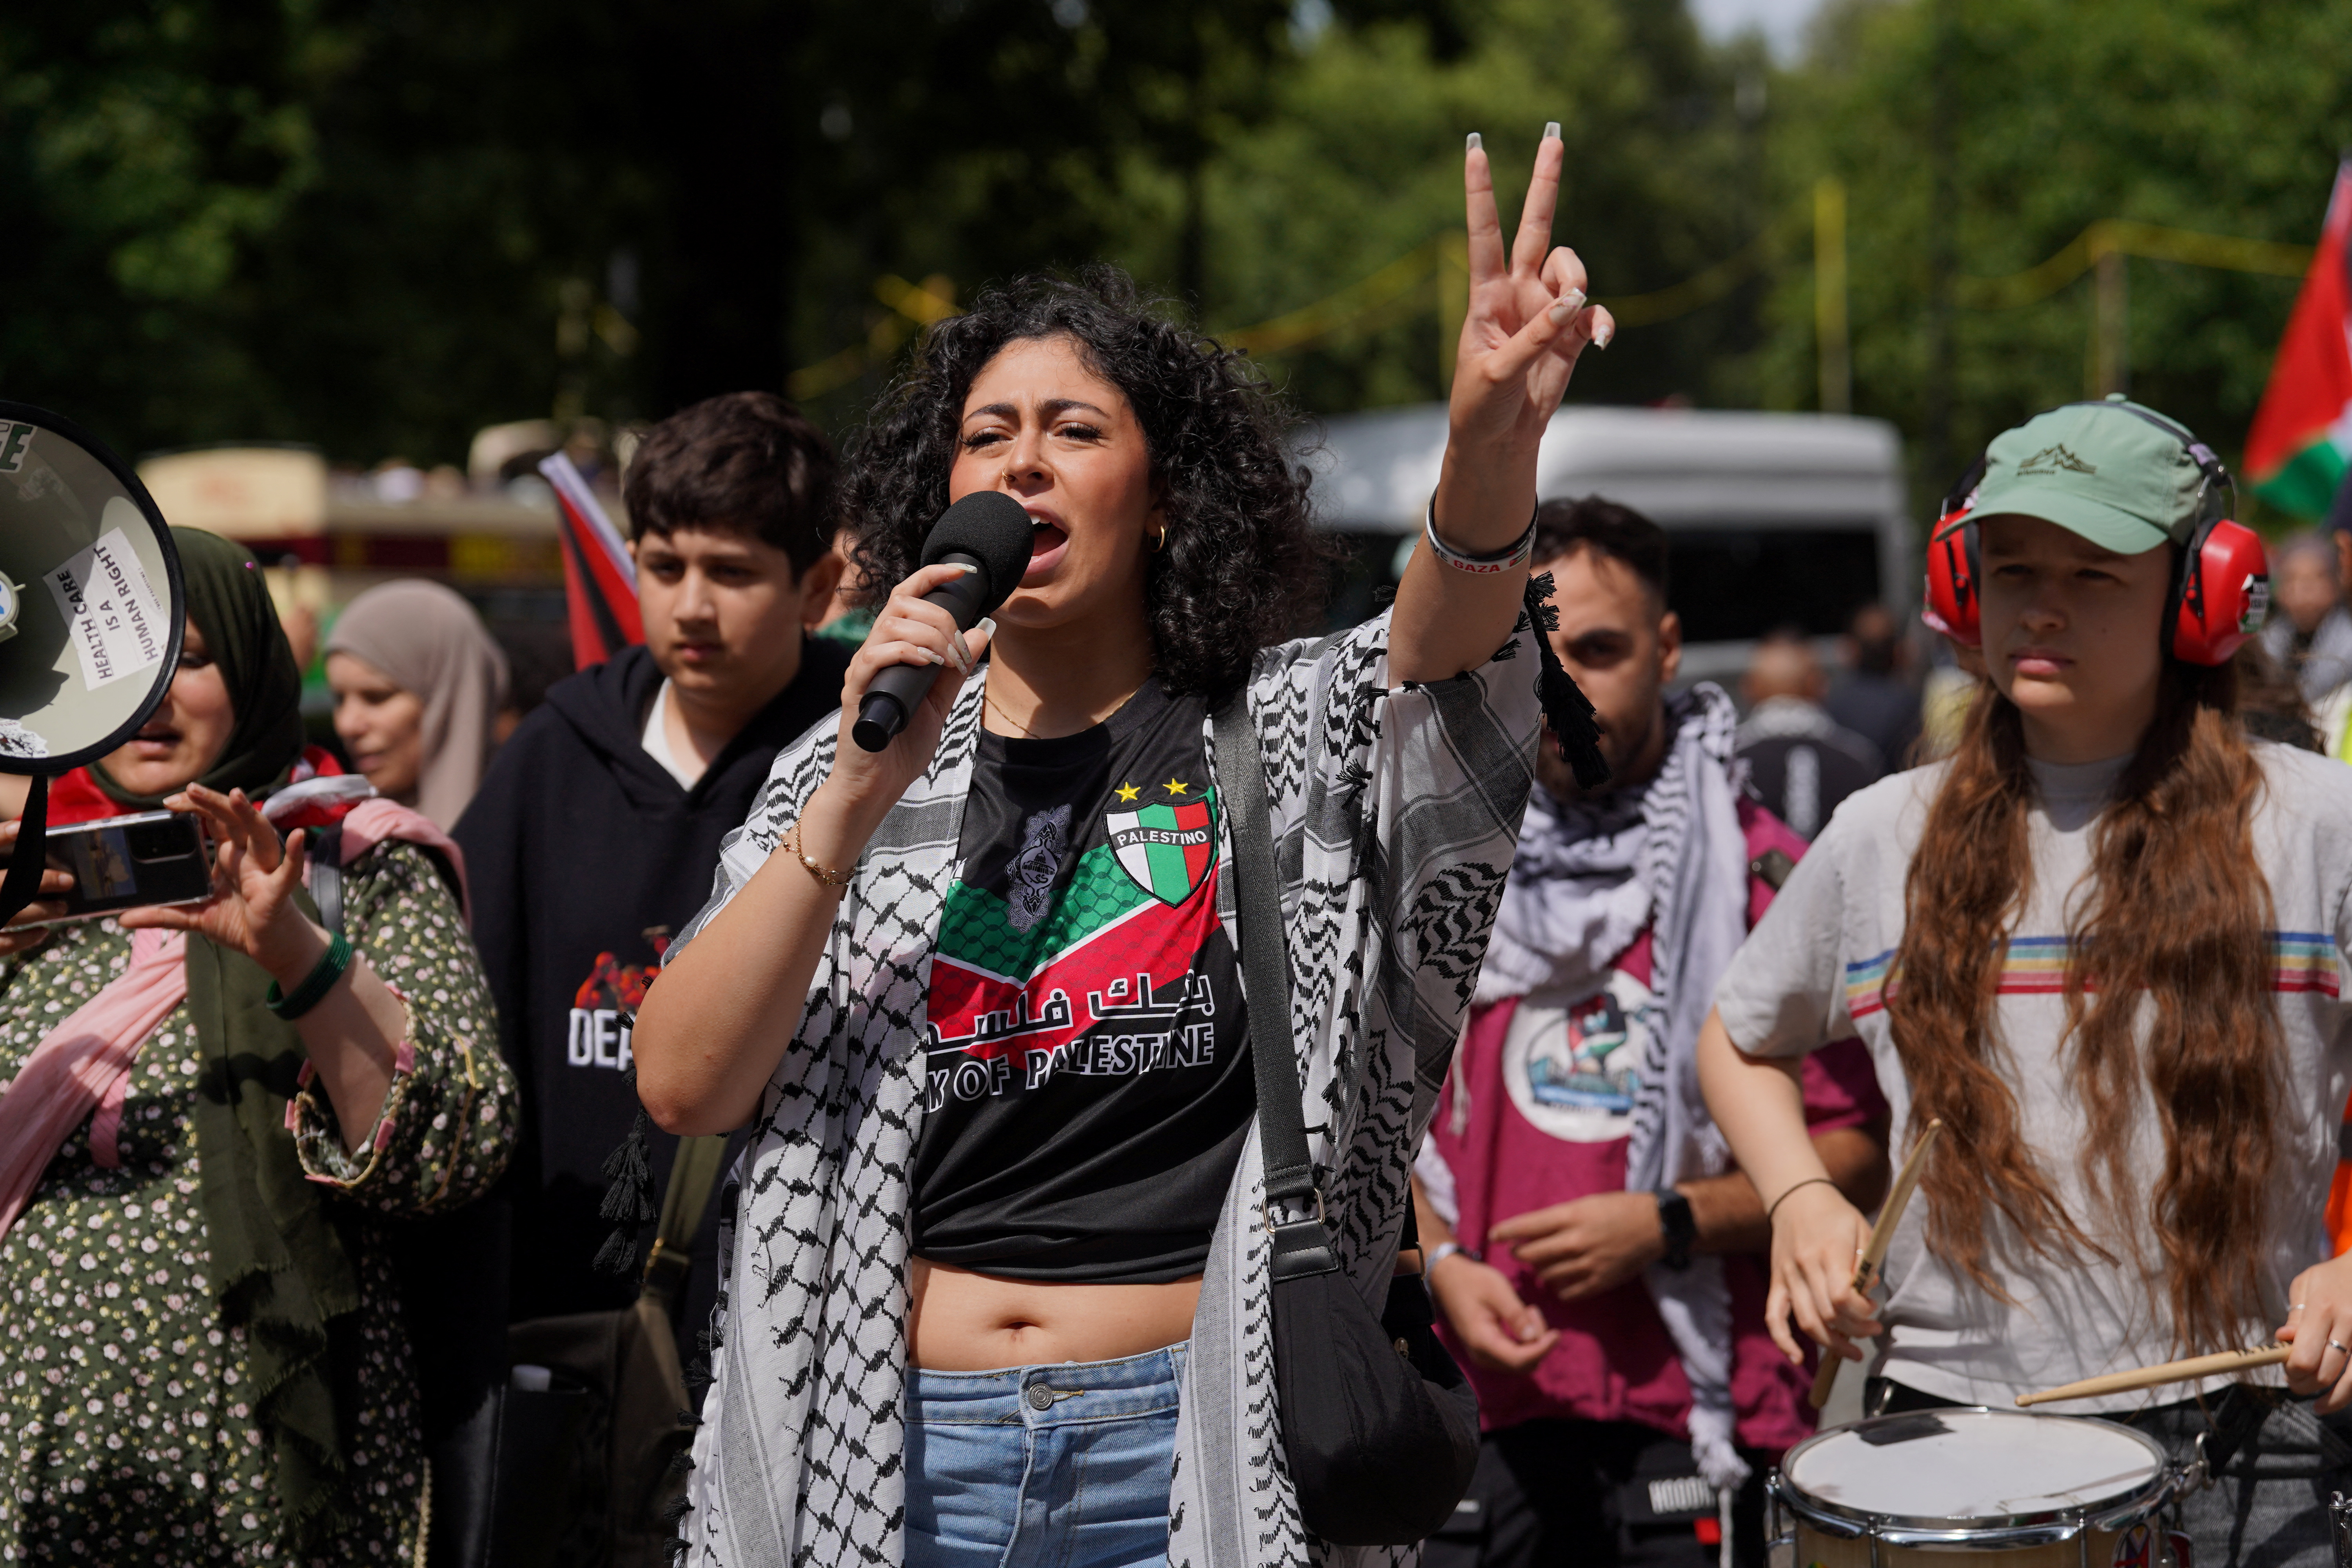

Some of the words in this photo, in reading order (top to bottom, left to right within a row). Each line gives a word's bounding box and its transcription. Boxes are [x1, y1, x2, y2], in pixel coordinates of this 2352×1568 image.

[93, 546, 131, 597] RIGHT
[1454, 560, 1501, 572] GAZA
[57, 570, 87, 615] CARE
[99, 600, 113, 611] A
[105, 617, 120, 631] IS
[125, 599, 158, 661] HUMAN
[80, 619, 112, 679] HEALTH
[1117, 830, 1207, 846] PALESTINO
[1087, 969, 1216, 1020] بنك
[953, 1053, 1011, 1101] OF
[1025, 1022, 1214, 1090] PALESTINE
